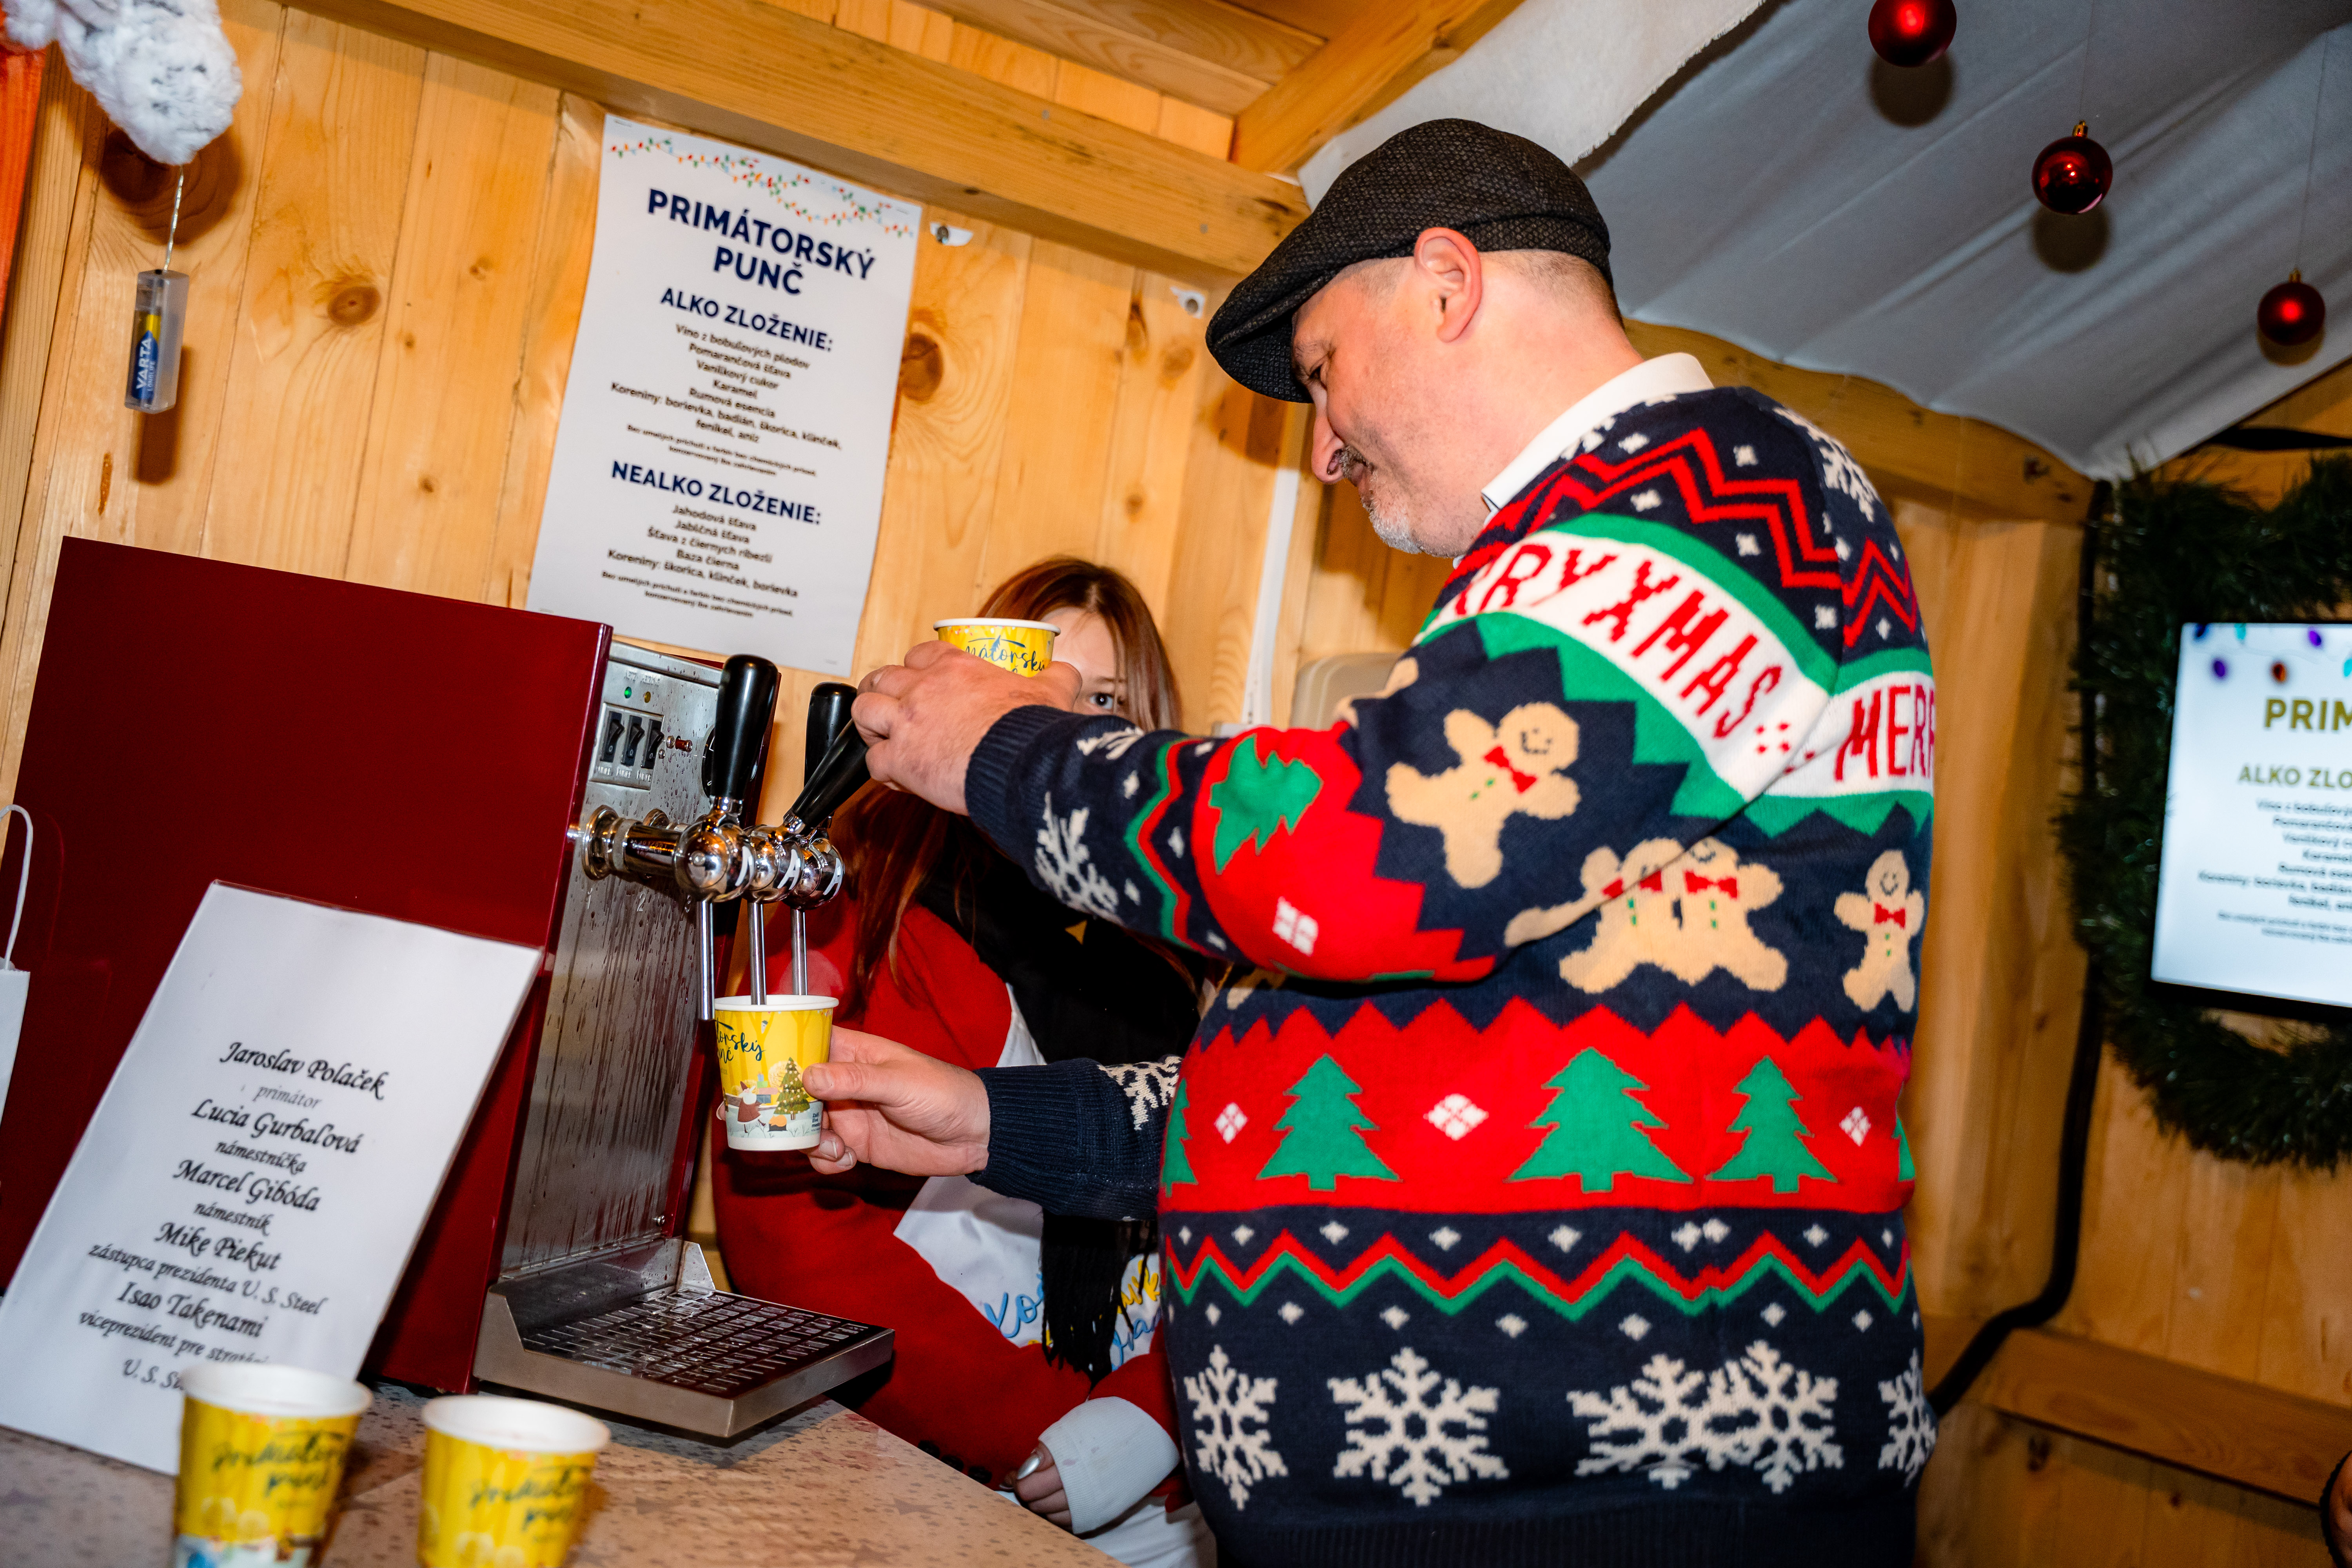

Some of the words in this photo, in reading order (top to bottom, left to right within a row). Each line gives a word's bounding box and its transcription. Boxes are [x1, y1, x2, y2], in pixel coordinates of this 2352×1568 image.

[648, 188, 876, 280] PRIMÁTORSKÝ
[713, 246, 804, 296] PUNČ
[661, 288, 719, 318] ALKO
[724, 305, 833, 352] ZLOŽENIE:
[136, 338, 152, 389] VARTA
[713, 379, 758, 399] Karamel
[612, 461, 703, 497] NEALKO
[709, 481, 821, 525] ZLOŽENIE:
[672, 505, 725, 524] Jahodová
[1583, 561, 1782, 739] XMAS
[2239, 766, 2300, 785] ALKO
[220, 1042, 305, 1075] Jaroslav
[307, 1060, 389, 1100] Polaček
[253, 1085, 322, 1109] primátor
[192, 1099, 250, 1127] Lucia
[251, 1112, 364, 1154] Gurbaľová
[215, 1140, 308, 1175] námestníčka
[174, 1159, 249, 1193] Marcel
[246, 1178, 321, 1212] Gibóda
[194, 1202, 270, 1236] námestník
[154, 1222, 211, 1256] Mike
[214, 1237, 281, 1273] Piekut
[88, 1244, 155, 1272] zástupca
[154, 1261, 236, 1293] prezidenta
[242, 1281, 258, 1299] U.
[262, 1289, 277, 1305] S.
[280, 1292, 329, 1316] Steel
[80, 1310, 176, 1350] viceprezident
[177, 1339, 204, 1357] pre
[117, 1282, 162, 1310] Isao
[166, 1294, 269, 1338] Takenami
[123, 1359, 142, 1378] U.
[141, 1366, 159, 1383] S.
